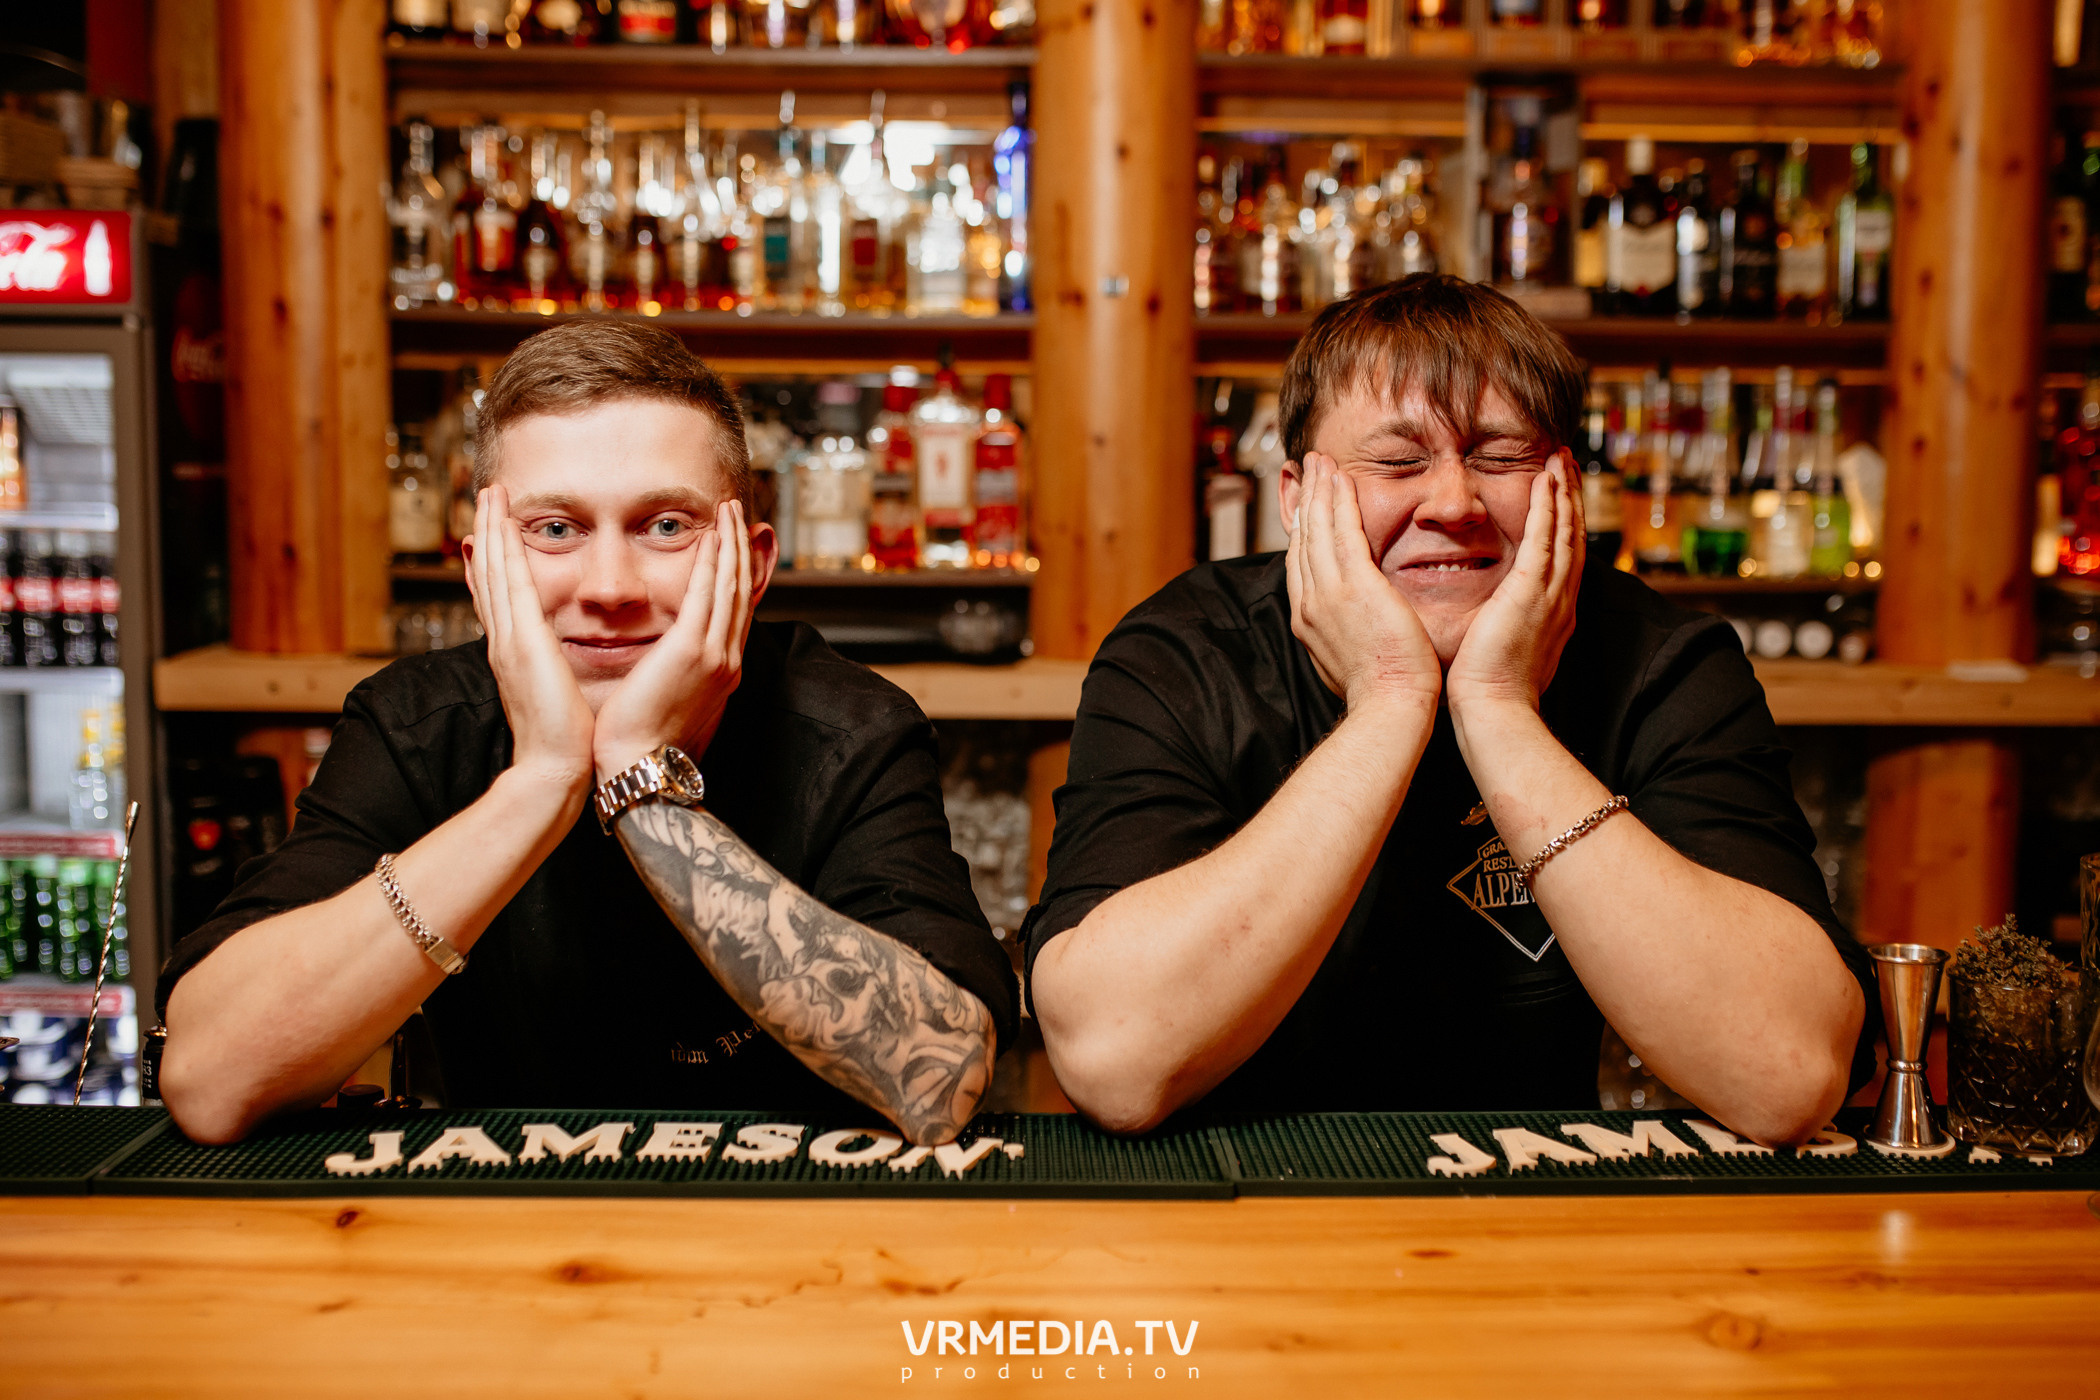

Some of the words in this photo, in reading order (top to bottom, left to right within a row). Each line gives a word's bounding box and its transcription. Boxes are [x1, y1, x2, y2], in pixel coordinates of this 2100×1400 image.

[1482, 840, 1508, 857] GRA
[1483, 856, 1517, 872] REST
[324, 1121, 1004, 1181] JAMESON
